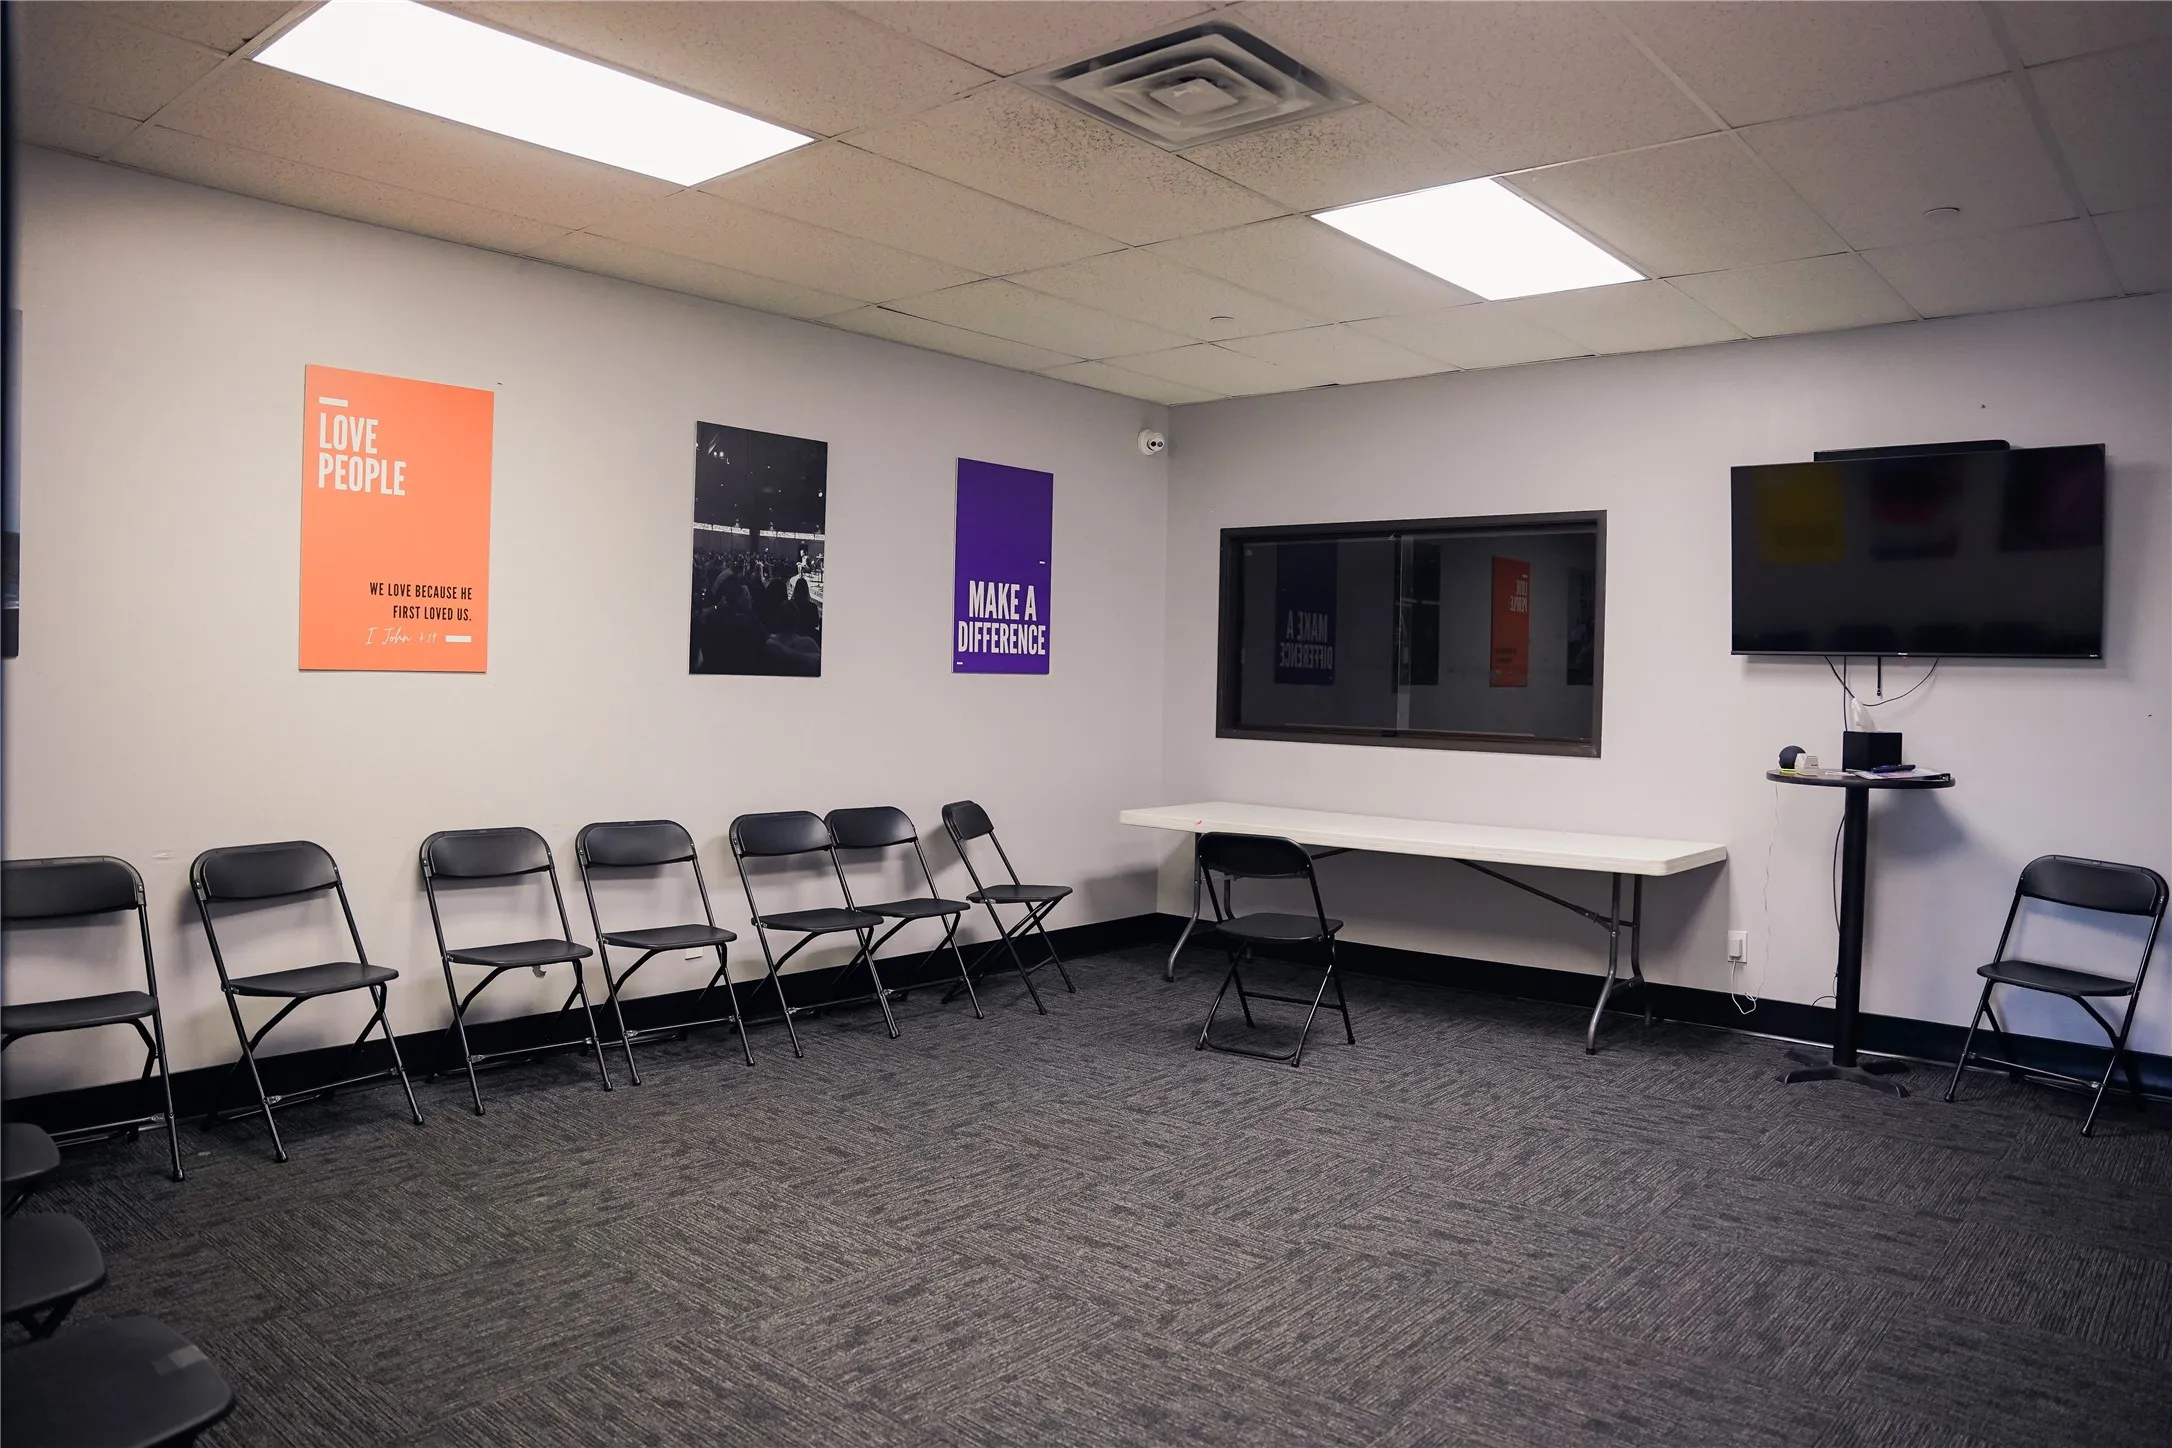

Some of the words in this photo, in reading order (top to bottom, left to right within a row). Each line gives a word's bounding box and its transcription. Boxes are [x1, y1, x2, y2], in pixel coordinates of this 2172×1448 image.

[320, 412, 379, 454] LOVE
[318, 451, 407, 496] PEOPLE
[369, 582, 384, 596] WE
[388, 583, 411, 597] LOVE
[415, 584, 457, 600] BECAUSE
[460, 587, 472, 600] HE
[969, 580, 1020, 620] MAKE
[1024, 585, 1037, 621] A
[393, 605, 420, 619] FIRST
[424, 606, 453, 621] LOVED
[457, 608, 472, 622] US.
[365, 627, 378, 645] I
[381, 626, 411, 645] John
[958, 620, 1046, 655] DIFFERENCE
